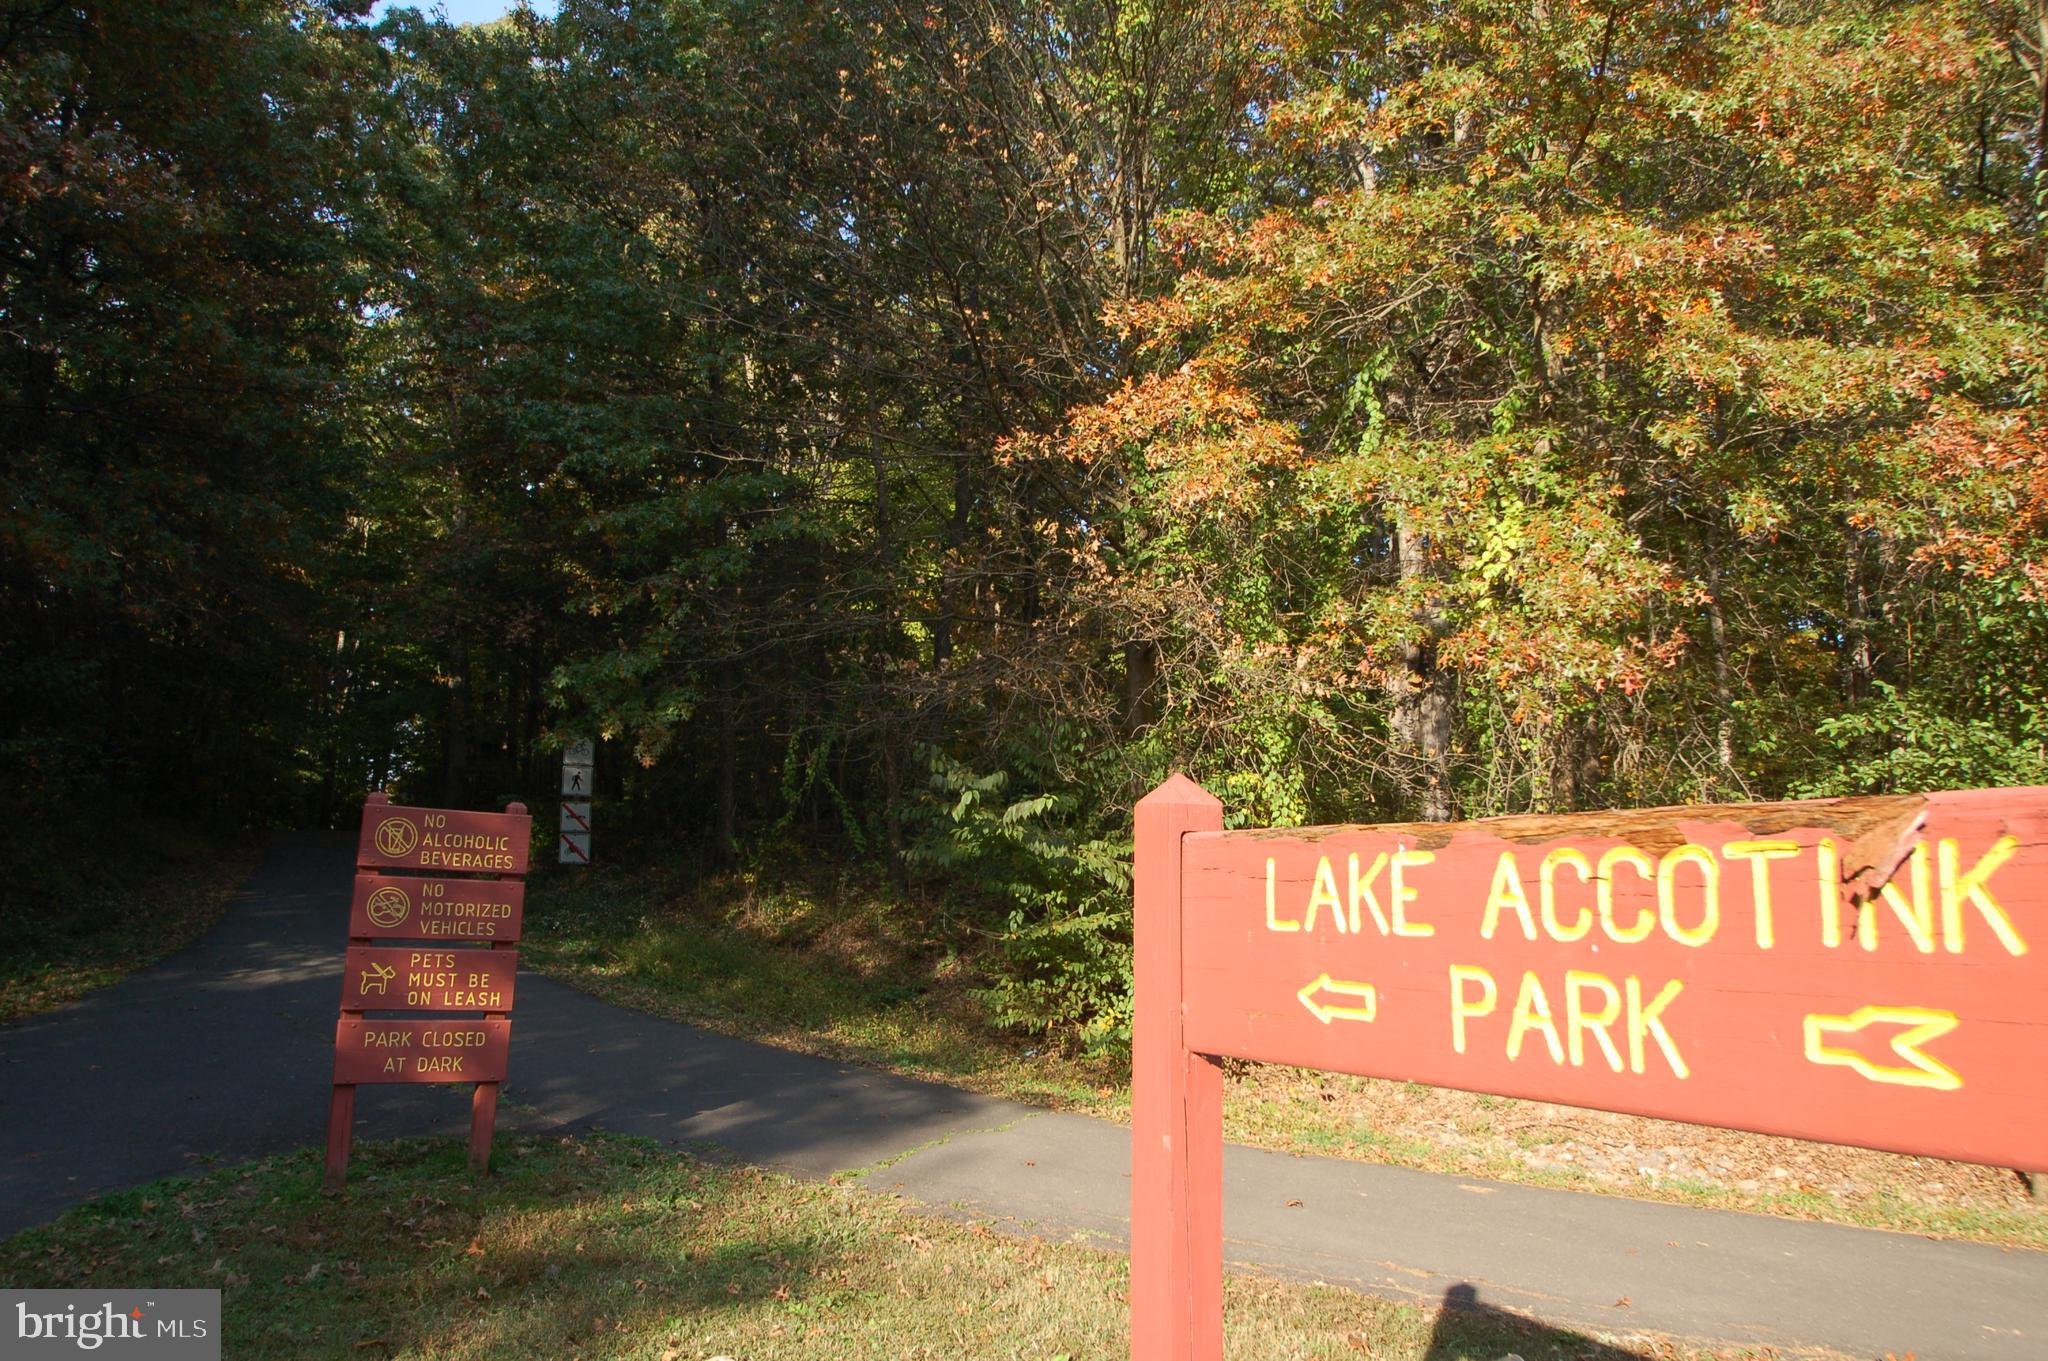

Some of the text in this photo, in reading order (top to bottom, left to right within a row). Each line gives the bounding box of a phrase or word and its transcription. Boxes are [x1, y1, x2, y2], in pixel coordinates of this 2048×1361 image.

[424, 814, 446, 829] NO
[422, 833, 509, 851] ALCOHOLIC
[420, 852, 514, 869] BEVERAGES
[423, 883, 445, 897] NO
[1265, 836, 2029, 957] LAKE ACCOTINK
[420, 902, 511, 919] MOTORIZED
[420, 920, 496, 936] VEHICLES
[410, 953, 455, 968] PETS
[409, 972, 490, 988] MUST BE
[408, 991, 501, 1007] ON LEASH
[1449, 964, 1690, 1080] PARK
[364, 1031, 486, 1047] PARK CLOSED
[384, 1056, 464, 1073] AT DARK
